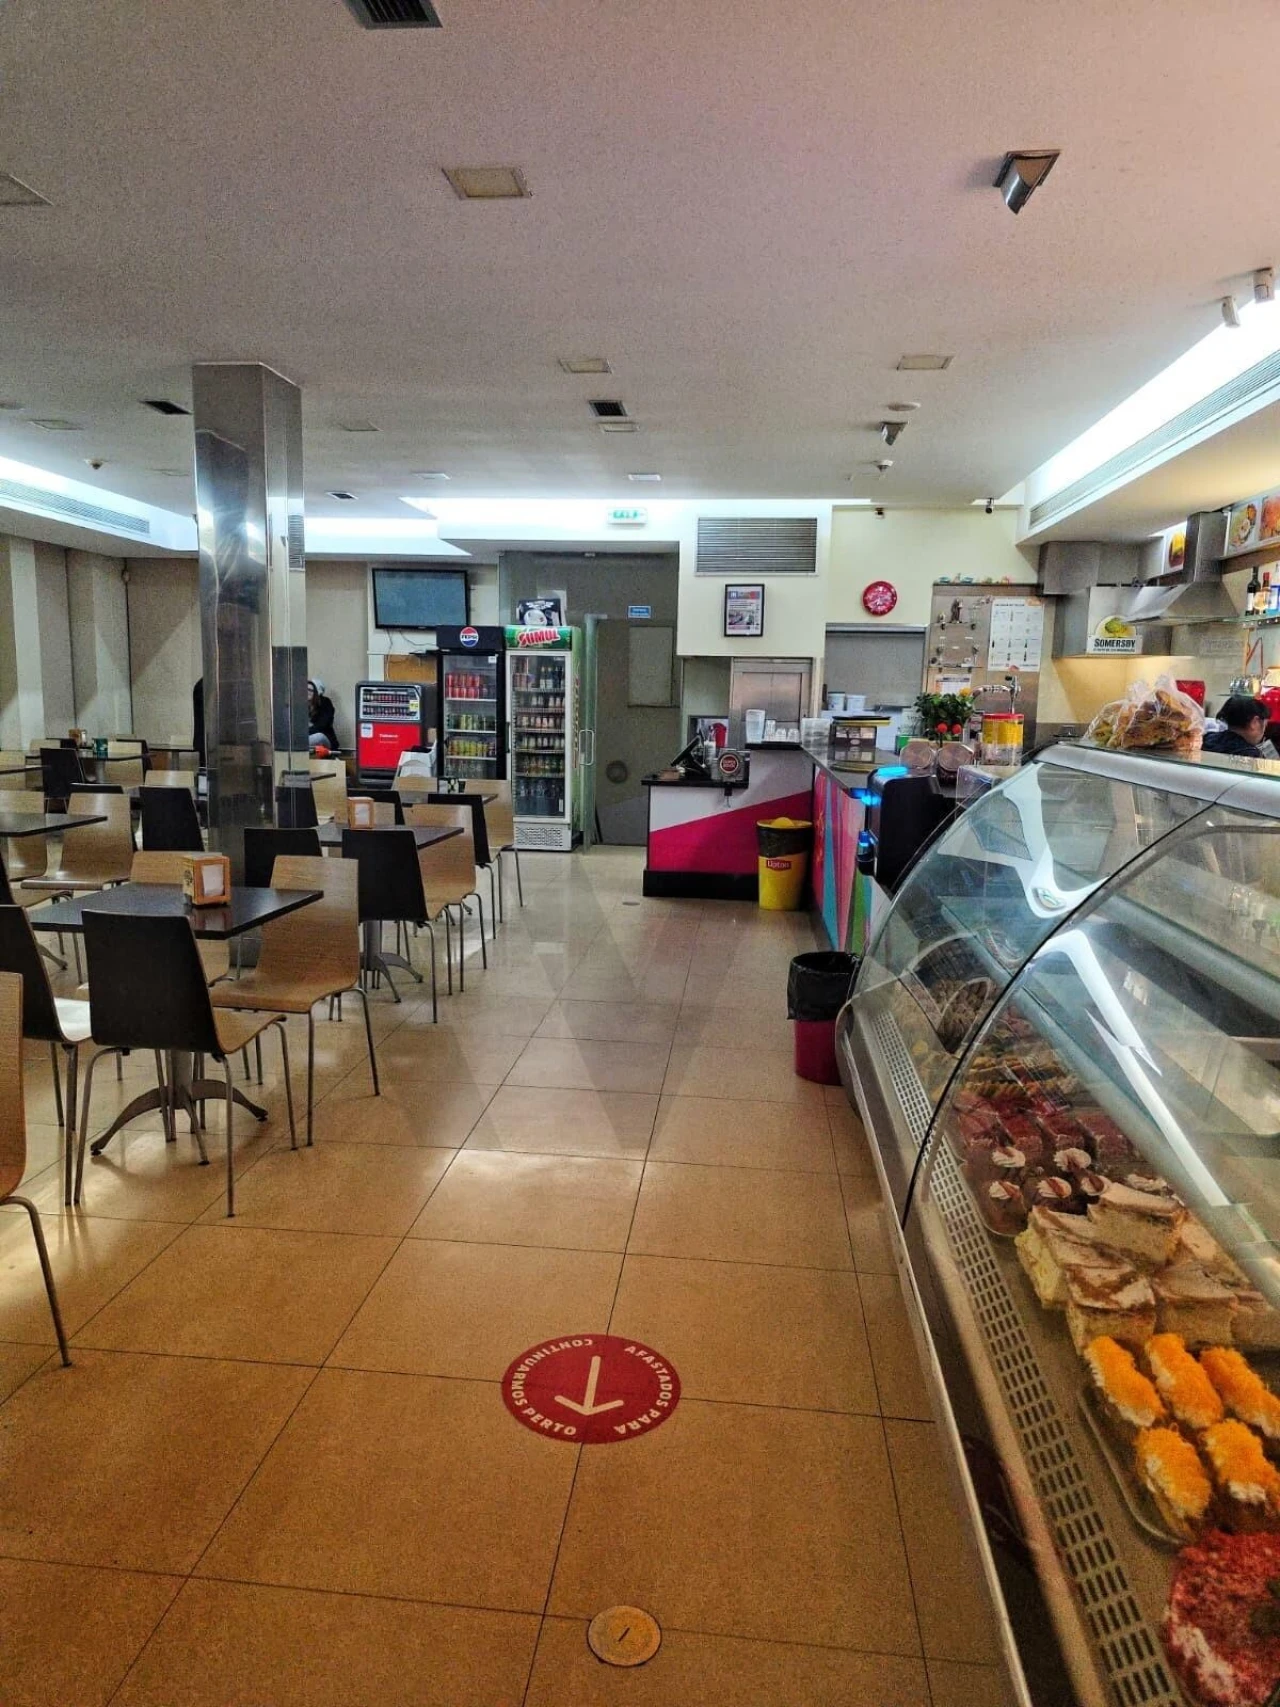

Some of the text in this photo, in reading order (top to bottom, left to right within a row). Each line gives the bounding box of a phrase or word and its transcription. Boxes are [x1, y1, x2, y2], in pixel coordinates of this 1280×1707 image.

[1094, 638, 1136, 648] SOMERSBY
[767, 861, 790, 869] Lipton
[511, 1338, 593, 1436] CONTINUARMOS PERTO
[613, 1345, 673, 1435] AFASTADOS PARA
